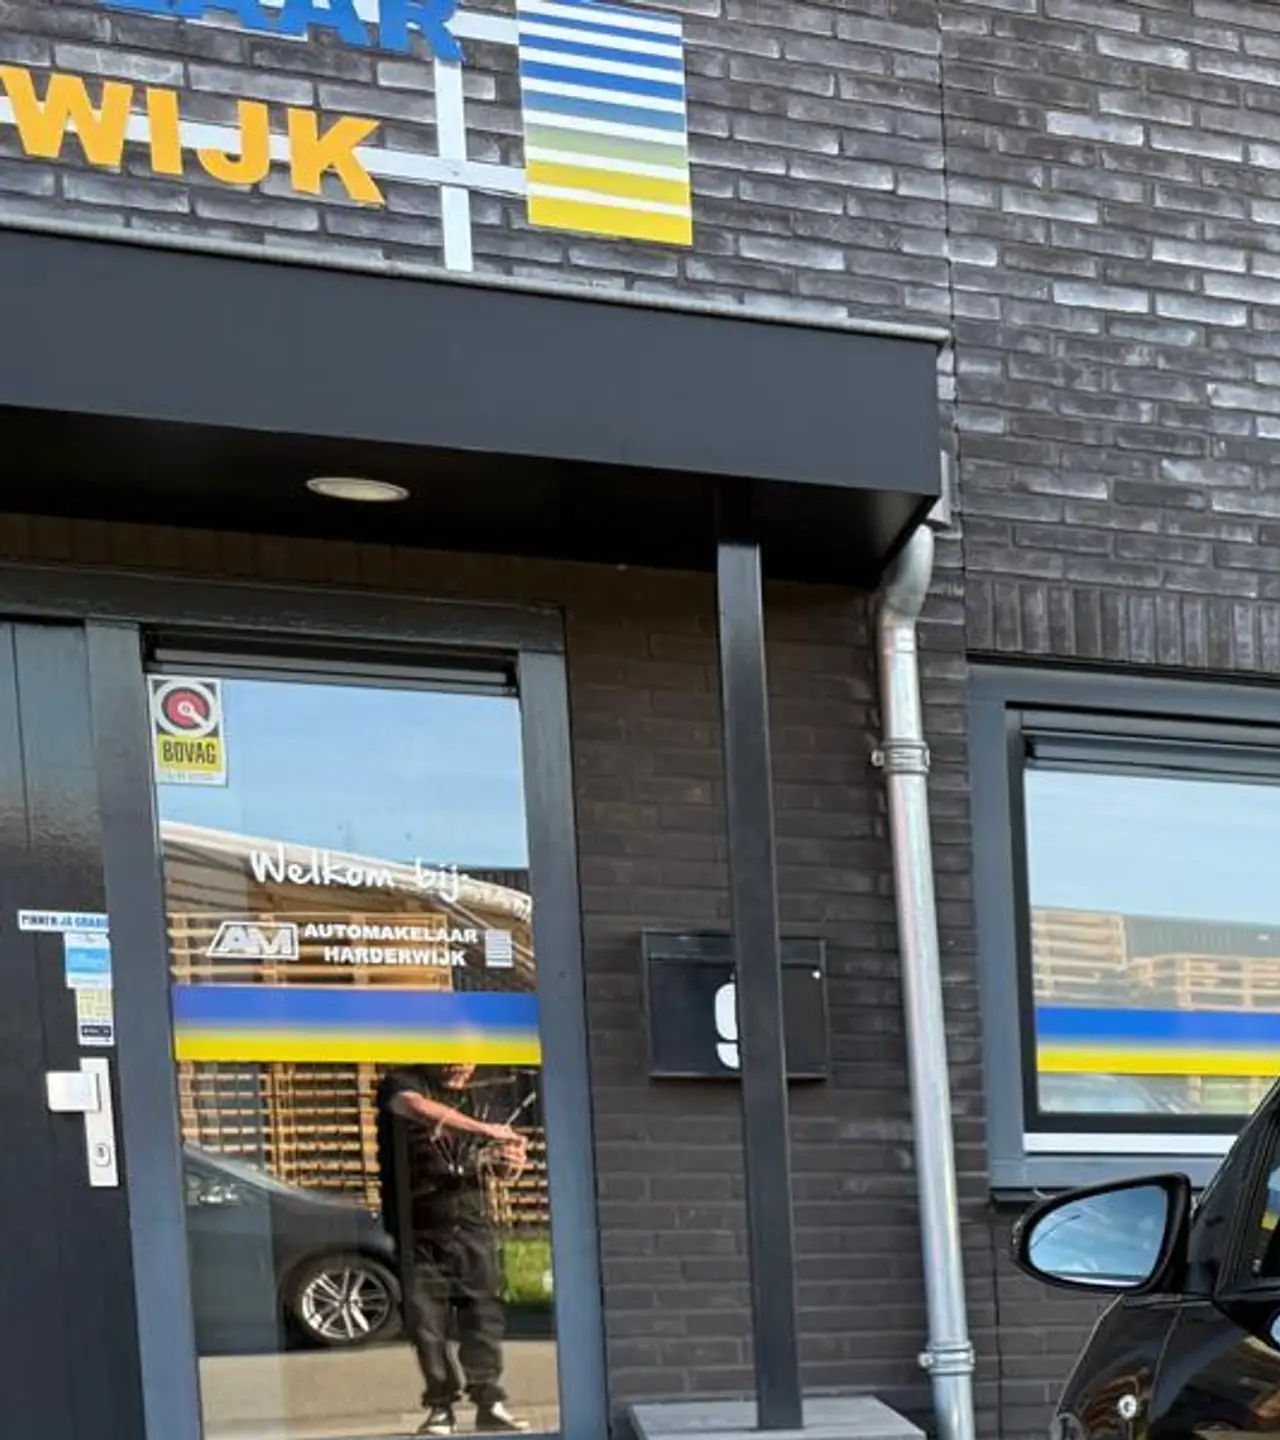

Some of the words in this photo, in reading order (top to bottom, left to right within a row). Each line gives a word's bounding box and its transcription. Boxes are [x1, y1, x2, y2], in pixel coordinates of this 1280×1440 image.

[162, 738, 217, 765] BOVAG
[251, 842, 395, 888] Welkom
[304, 922, 478, 945] AUTOMAKELAAR
[324, 945, 466, 968] HARDERWIJK
